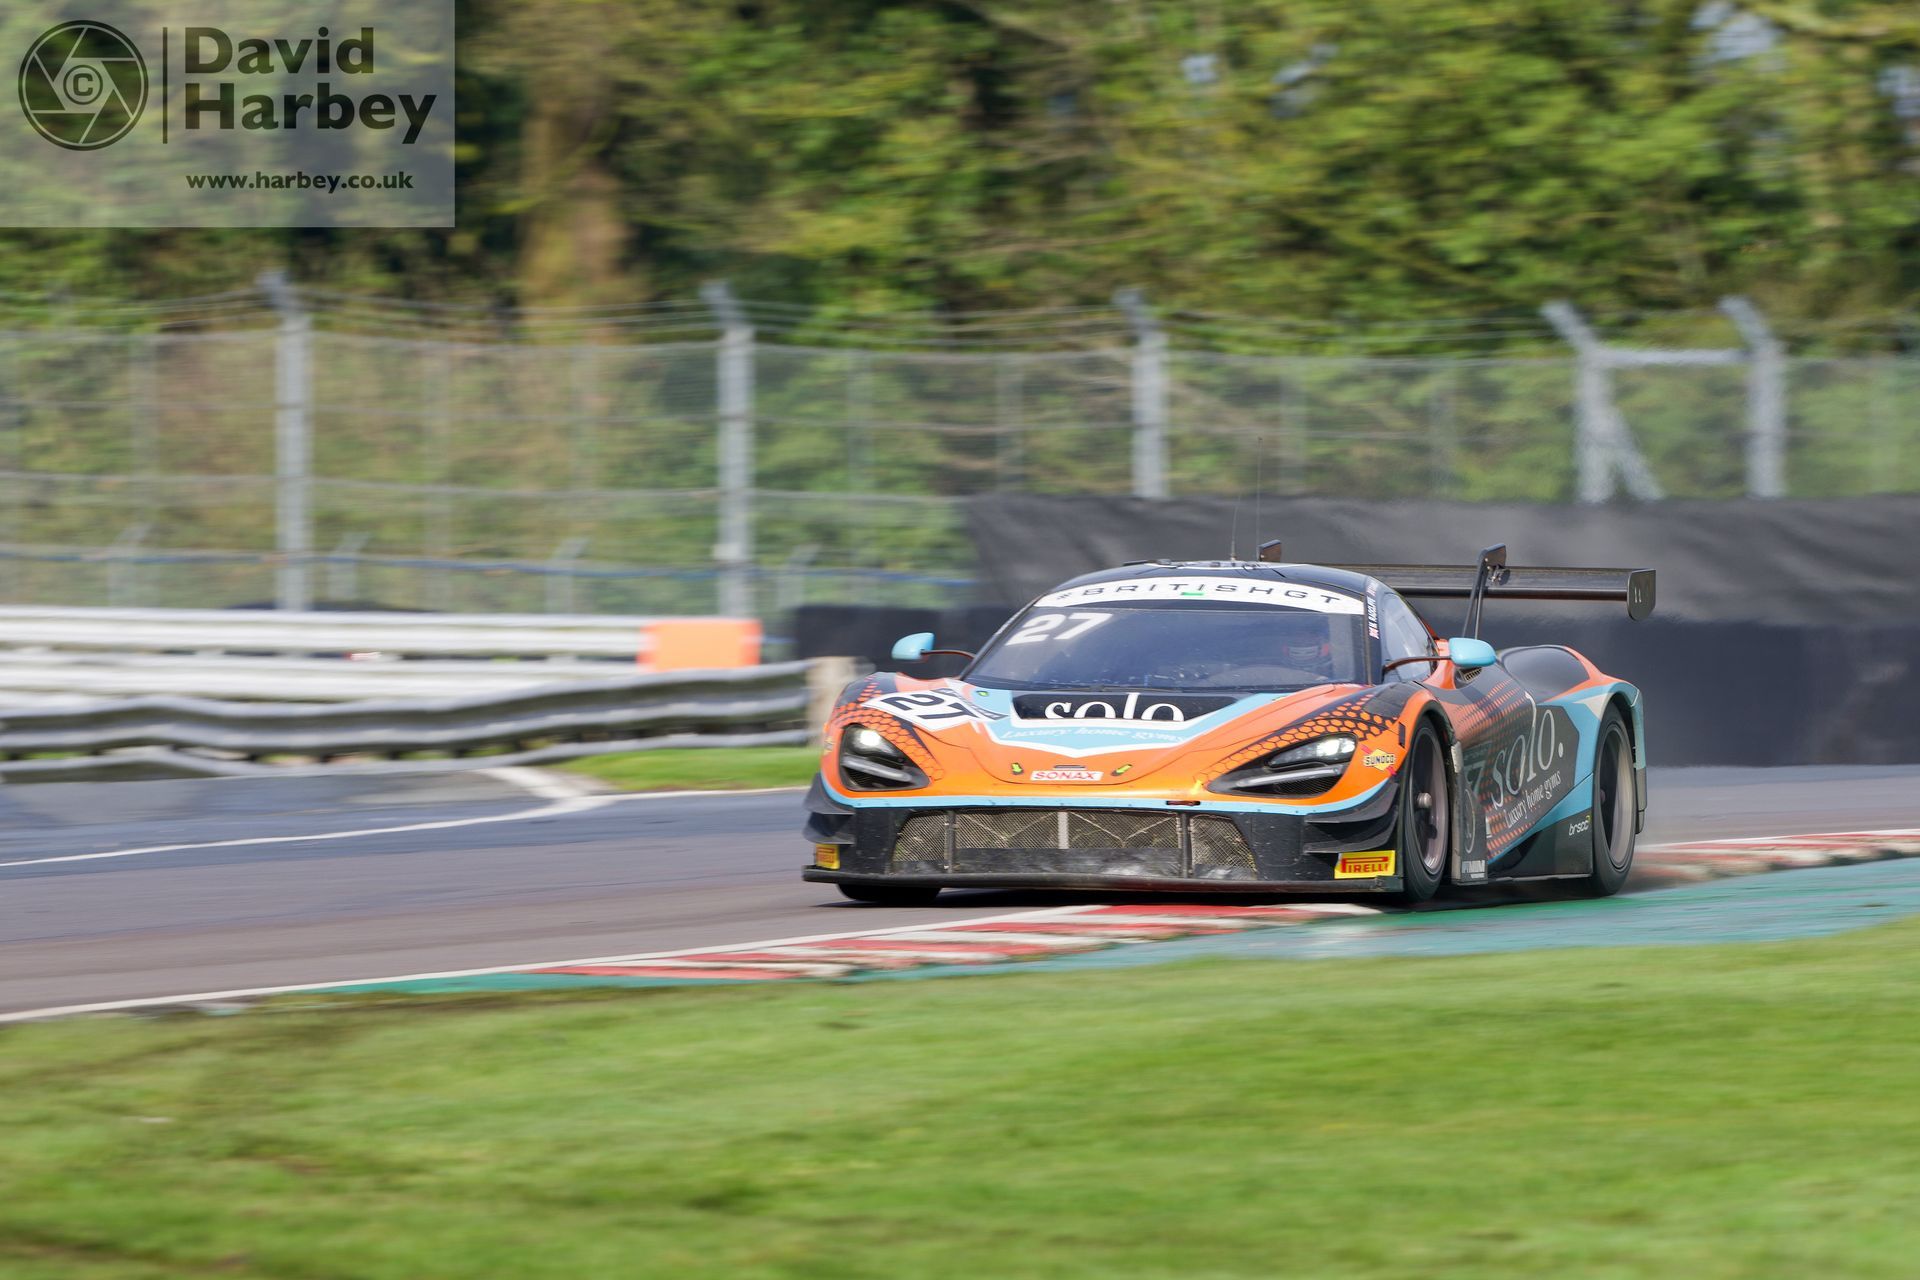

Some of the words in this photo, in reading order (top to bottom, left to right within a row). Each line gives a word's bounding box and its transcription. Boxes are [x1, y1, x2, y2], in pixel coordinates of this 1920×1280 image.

[1004, 612, 1115, 646] 27
[880, 693, 980, 720] 27
[1075, 726, 1131, 737] home
[1365, 755, 1395, 765] SUNOCO
[1034, 771, 1101, 780] SONAX
[1525, 784, 1545, 810] home
[1341, 856, 1389, 873] PIRELLI
